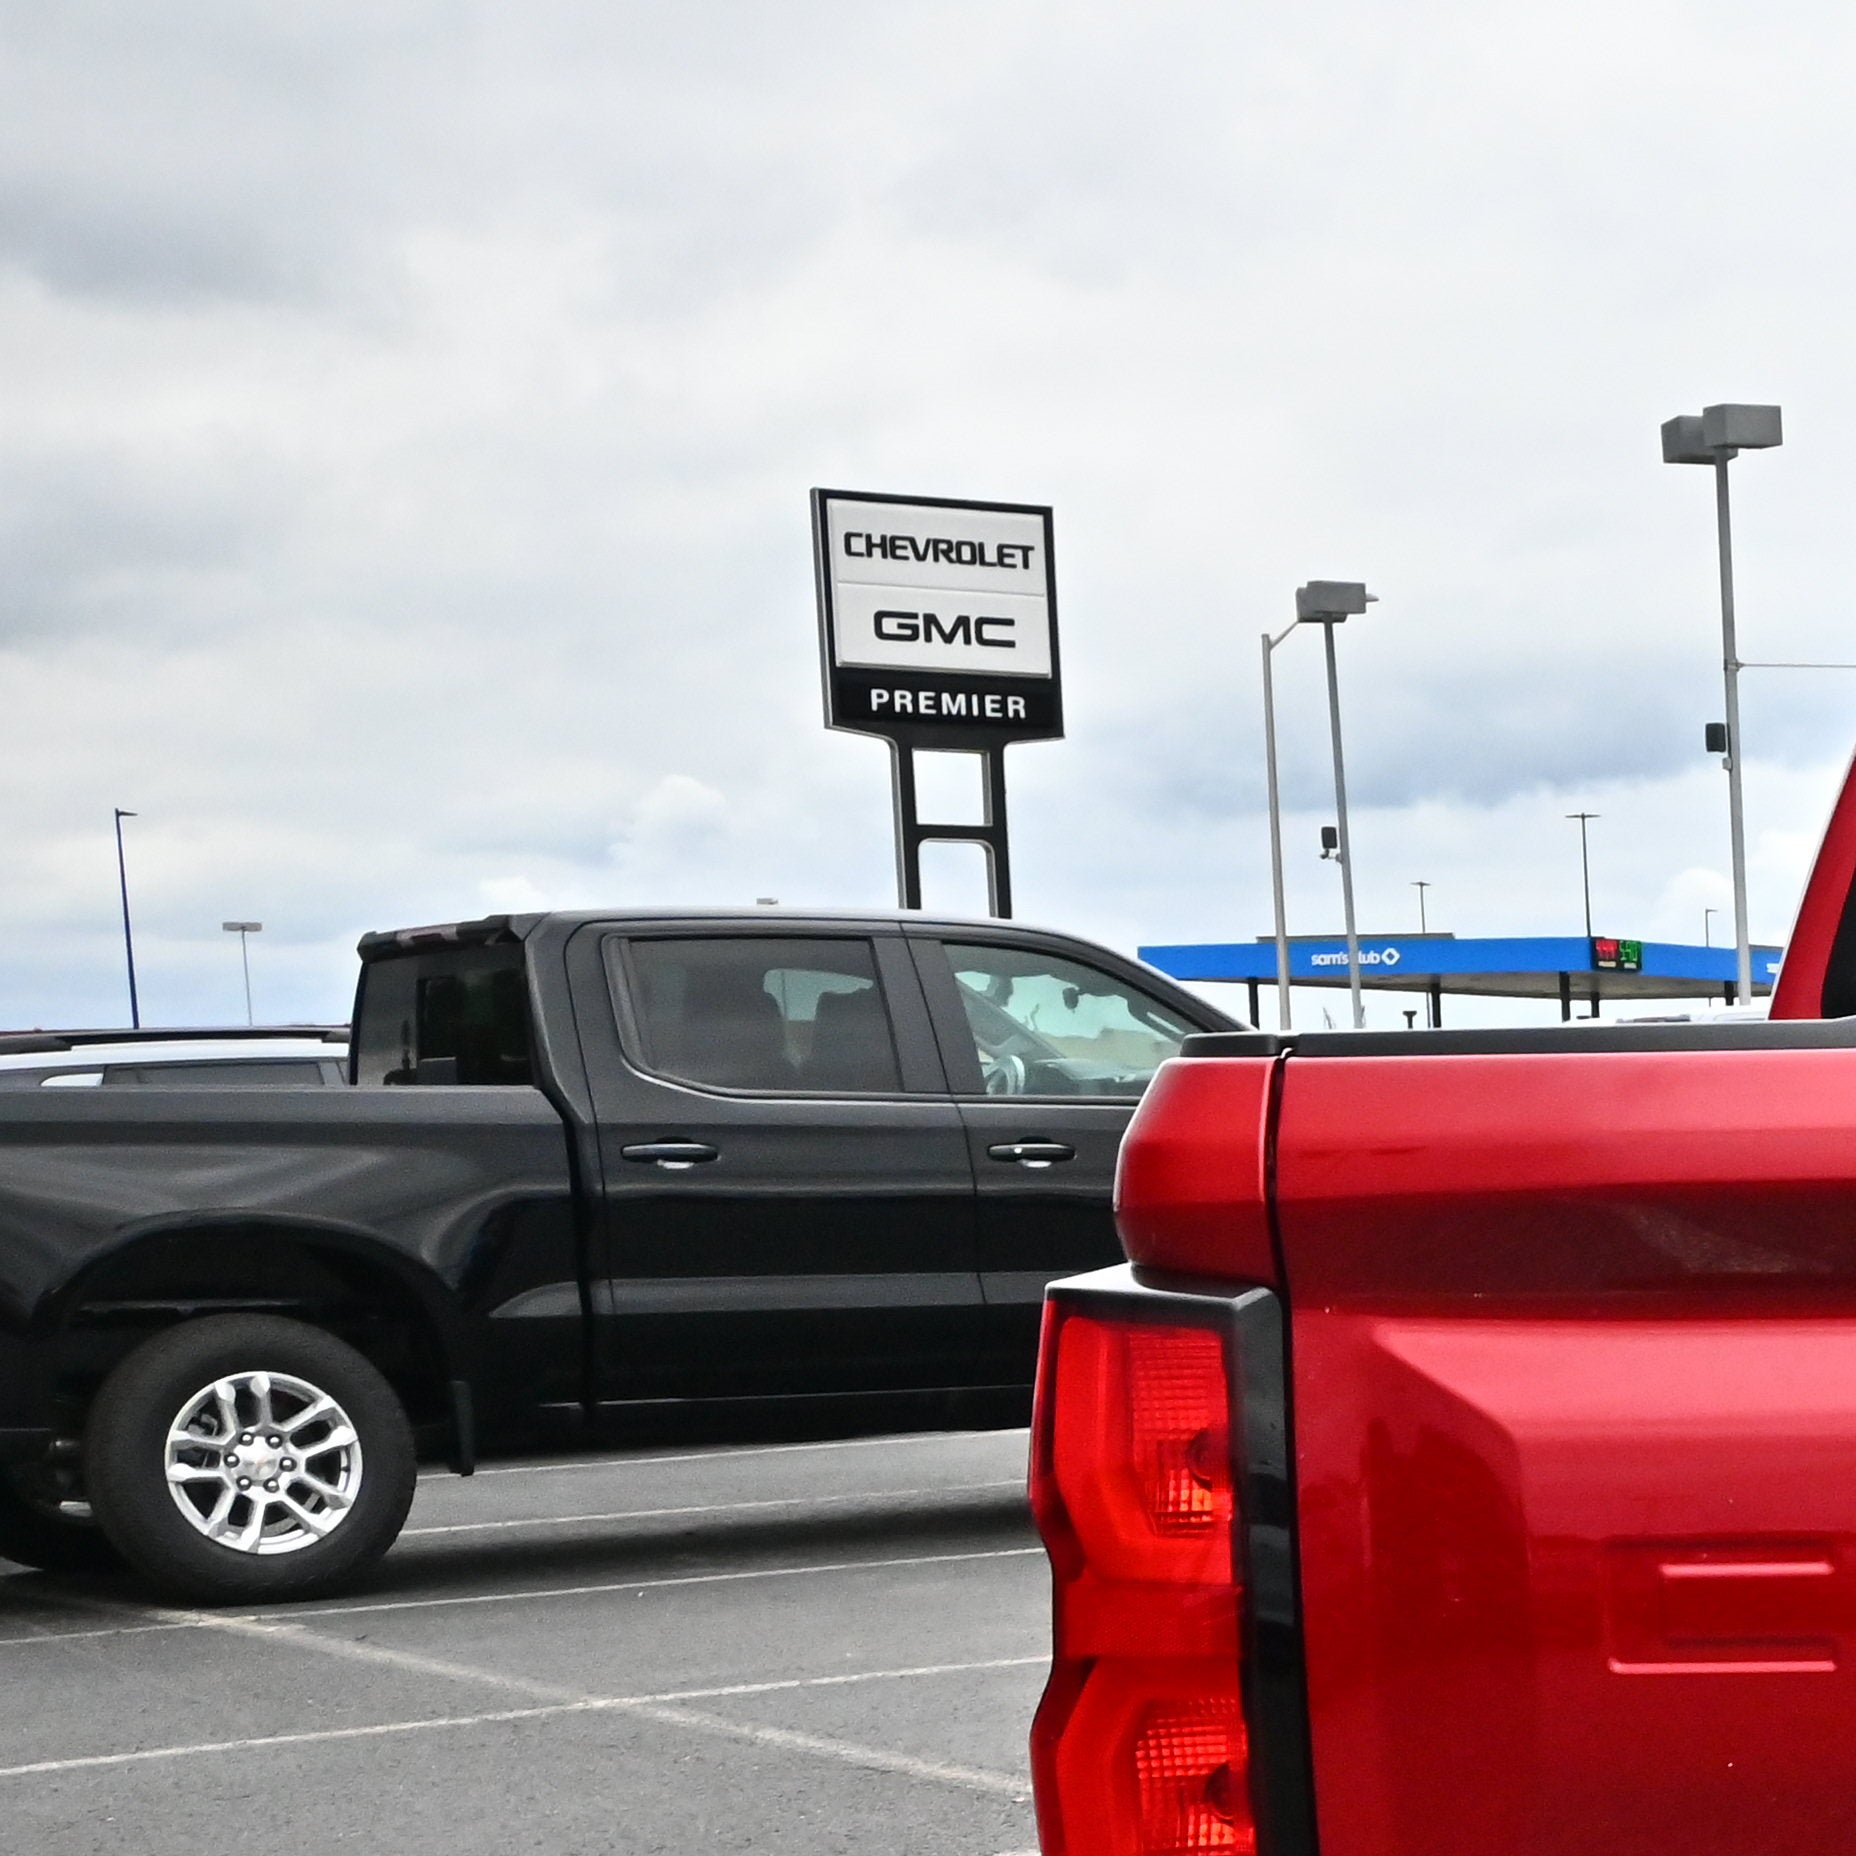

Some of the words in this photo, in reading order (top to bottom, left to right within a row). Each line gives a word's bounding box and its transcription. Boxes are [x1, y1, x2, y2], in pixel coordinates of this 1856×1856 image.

[843, 530, 1035, 570] CHEVROLET
[873, 609, 1016, 649] GMC
[870, 688, 1027, 719] PREMIER
